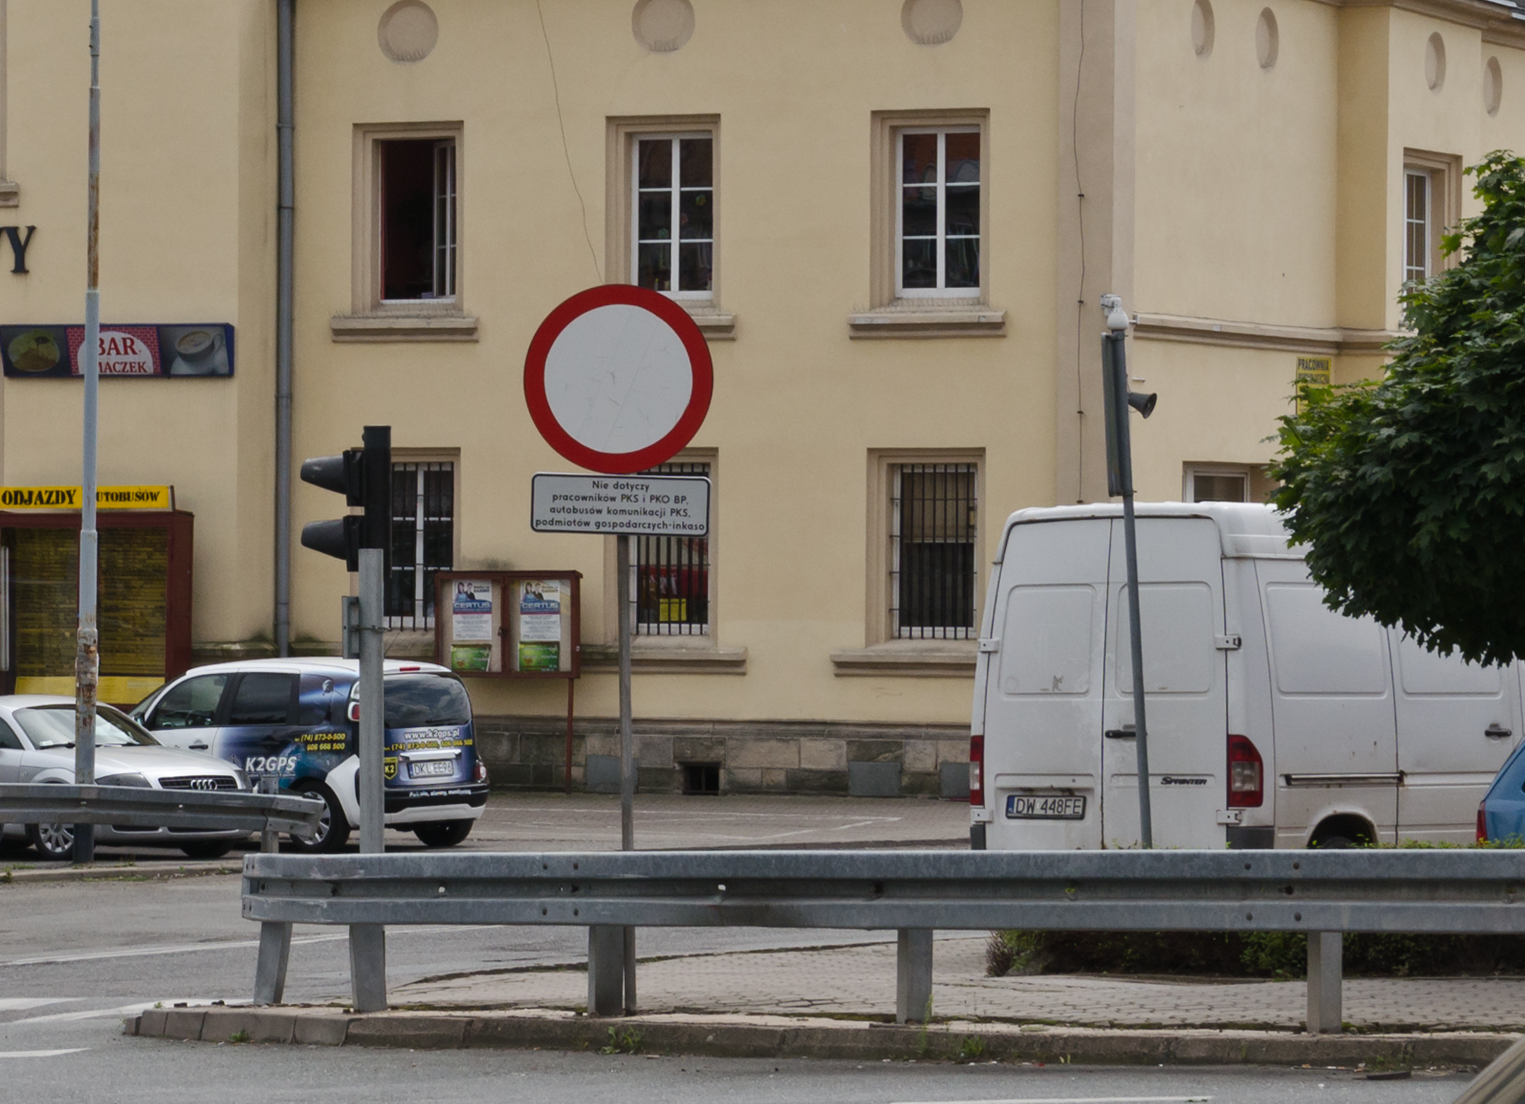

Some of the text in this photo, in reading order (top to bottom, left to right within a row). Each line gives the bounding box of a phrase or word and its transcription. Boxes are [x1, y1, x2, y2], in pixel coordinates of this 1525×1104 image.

[592, 480, 650, 492] Nie dotyczy
[1, 489, 161, 505] ODJAZDY UTOBUSÓW
[552, 493, 617, 503] pracowników
[620, 494, 639, 503] PKS
[649, 495, 670, 504] PKO
[549, 505, 603, 515] autobusów
[606, 507, 666, 519] komunikacji
[535, 517, 591, 528] podmiotów
[245, 756, 298, 772] K2GPS
[1015, 798, 1035, 814] DW
[1040, 799, 1082, 814] 448FE
